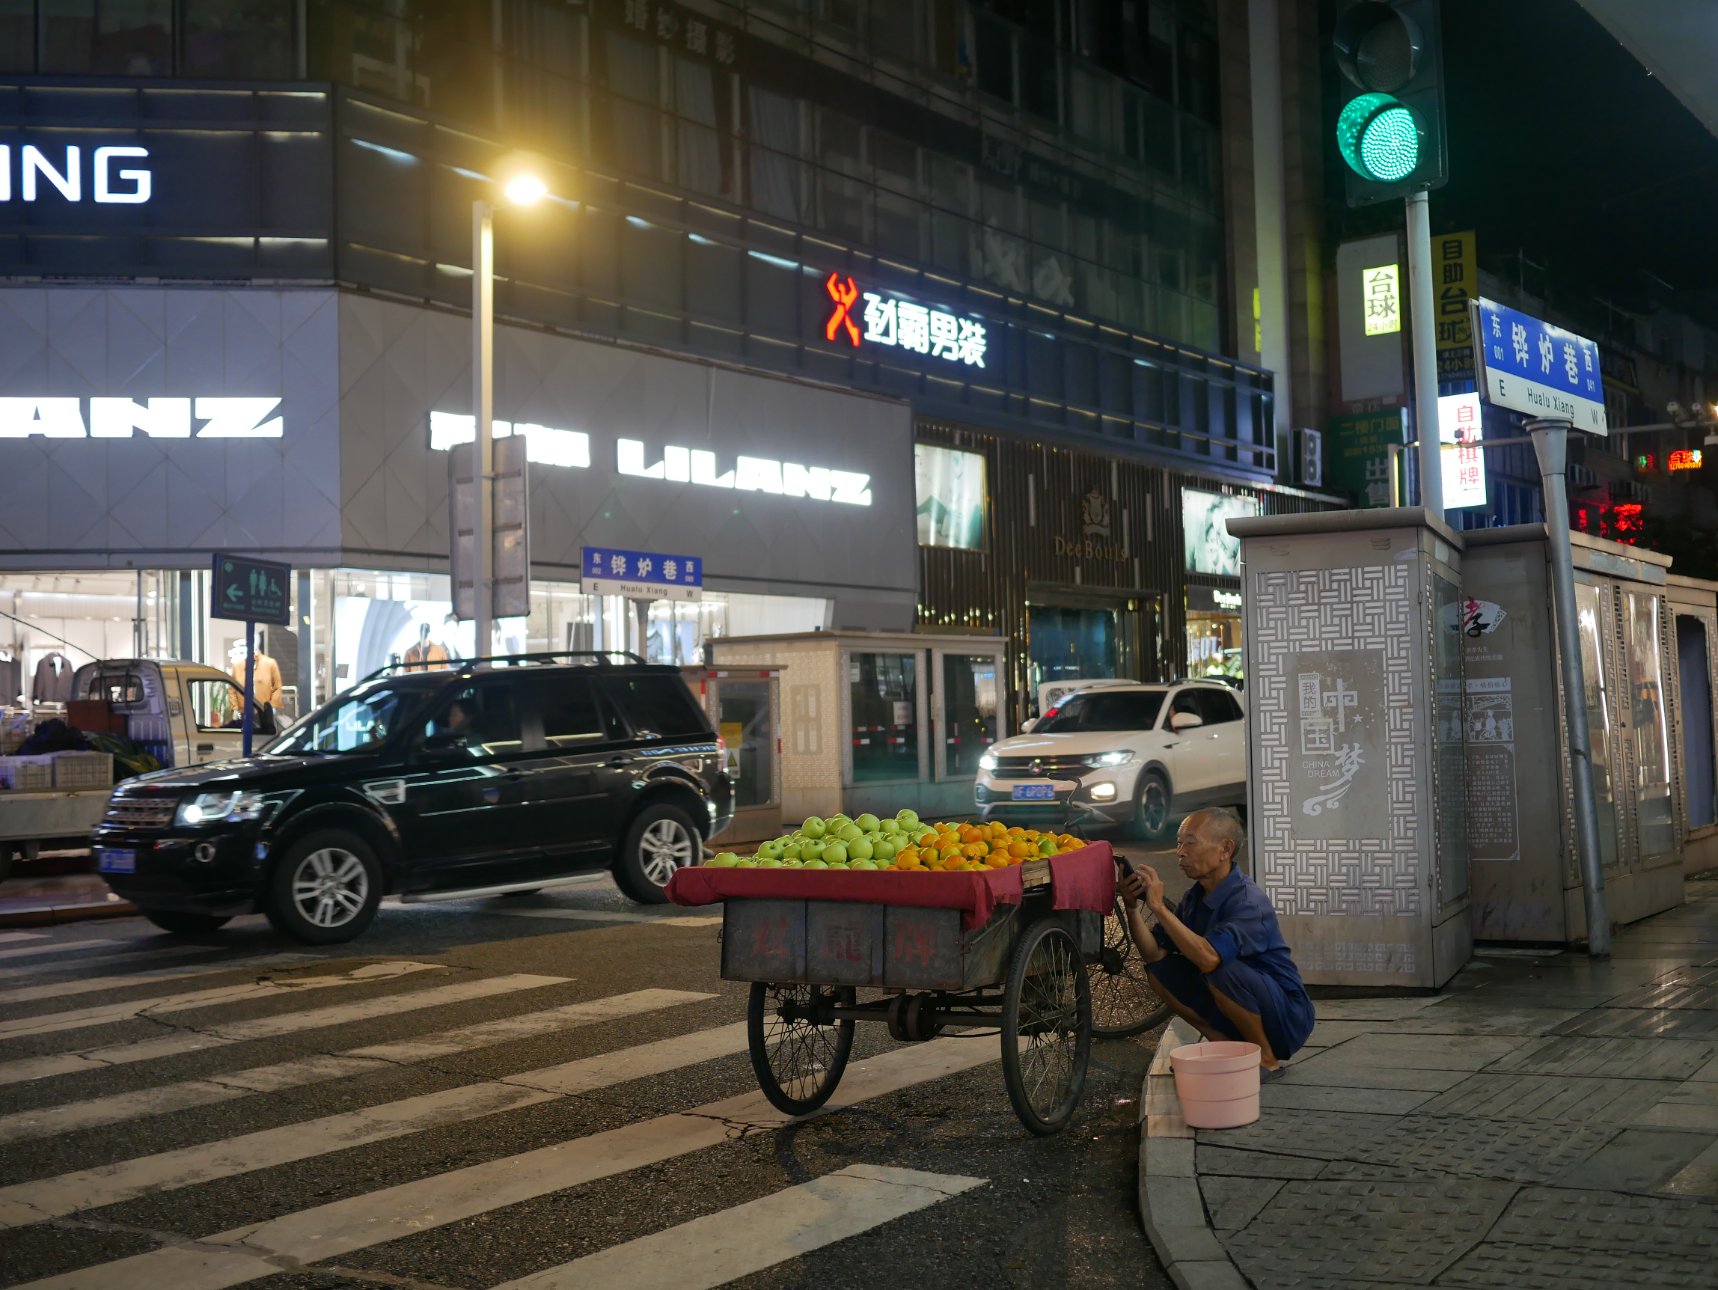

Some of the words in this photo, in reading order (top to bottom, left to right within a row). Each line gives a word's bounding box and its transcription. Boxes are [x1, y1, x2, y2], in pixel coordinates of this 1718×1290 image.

[1367, 270, 1397, 319] 台球
[863, 291, 987, 369] 劲霸男装
[1490, 313, 1502, 338] 东
[1511, 321, 1579, 385] 铧炉巷
[1583, 348, 1593, 373] 西
[1499, 379, 1506, 397] E
[1527, 387, 1551, 408] Hualu
[1553, 394, 1575, 420] Xiang
[1590, 410, 1599, 425] W
[617, 438, 872, 506] LILANZ
[592, 552, 602, 565] 东
[611, 554, 677, 580] 铧炉巷
[685, 560, 695, 573] 西
[593, 582, 599, 591] E
[620, 584, 643, 594] Hualu
[646, 586, 668, 597] Xiang
[686, 590, 694, 598] W
[1302, 680, 1317, 709] 我的
[1302, 760, 1330, 769] CHINA
[1307, 769, 1340, 778] DREAM
